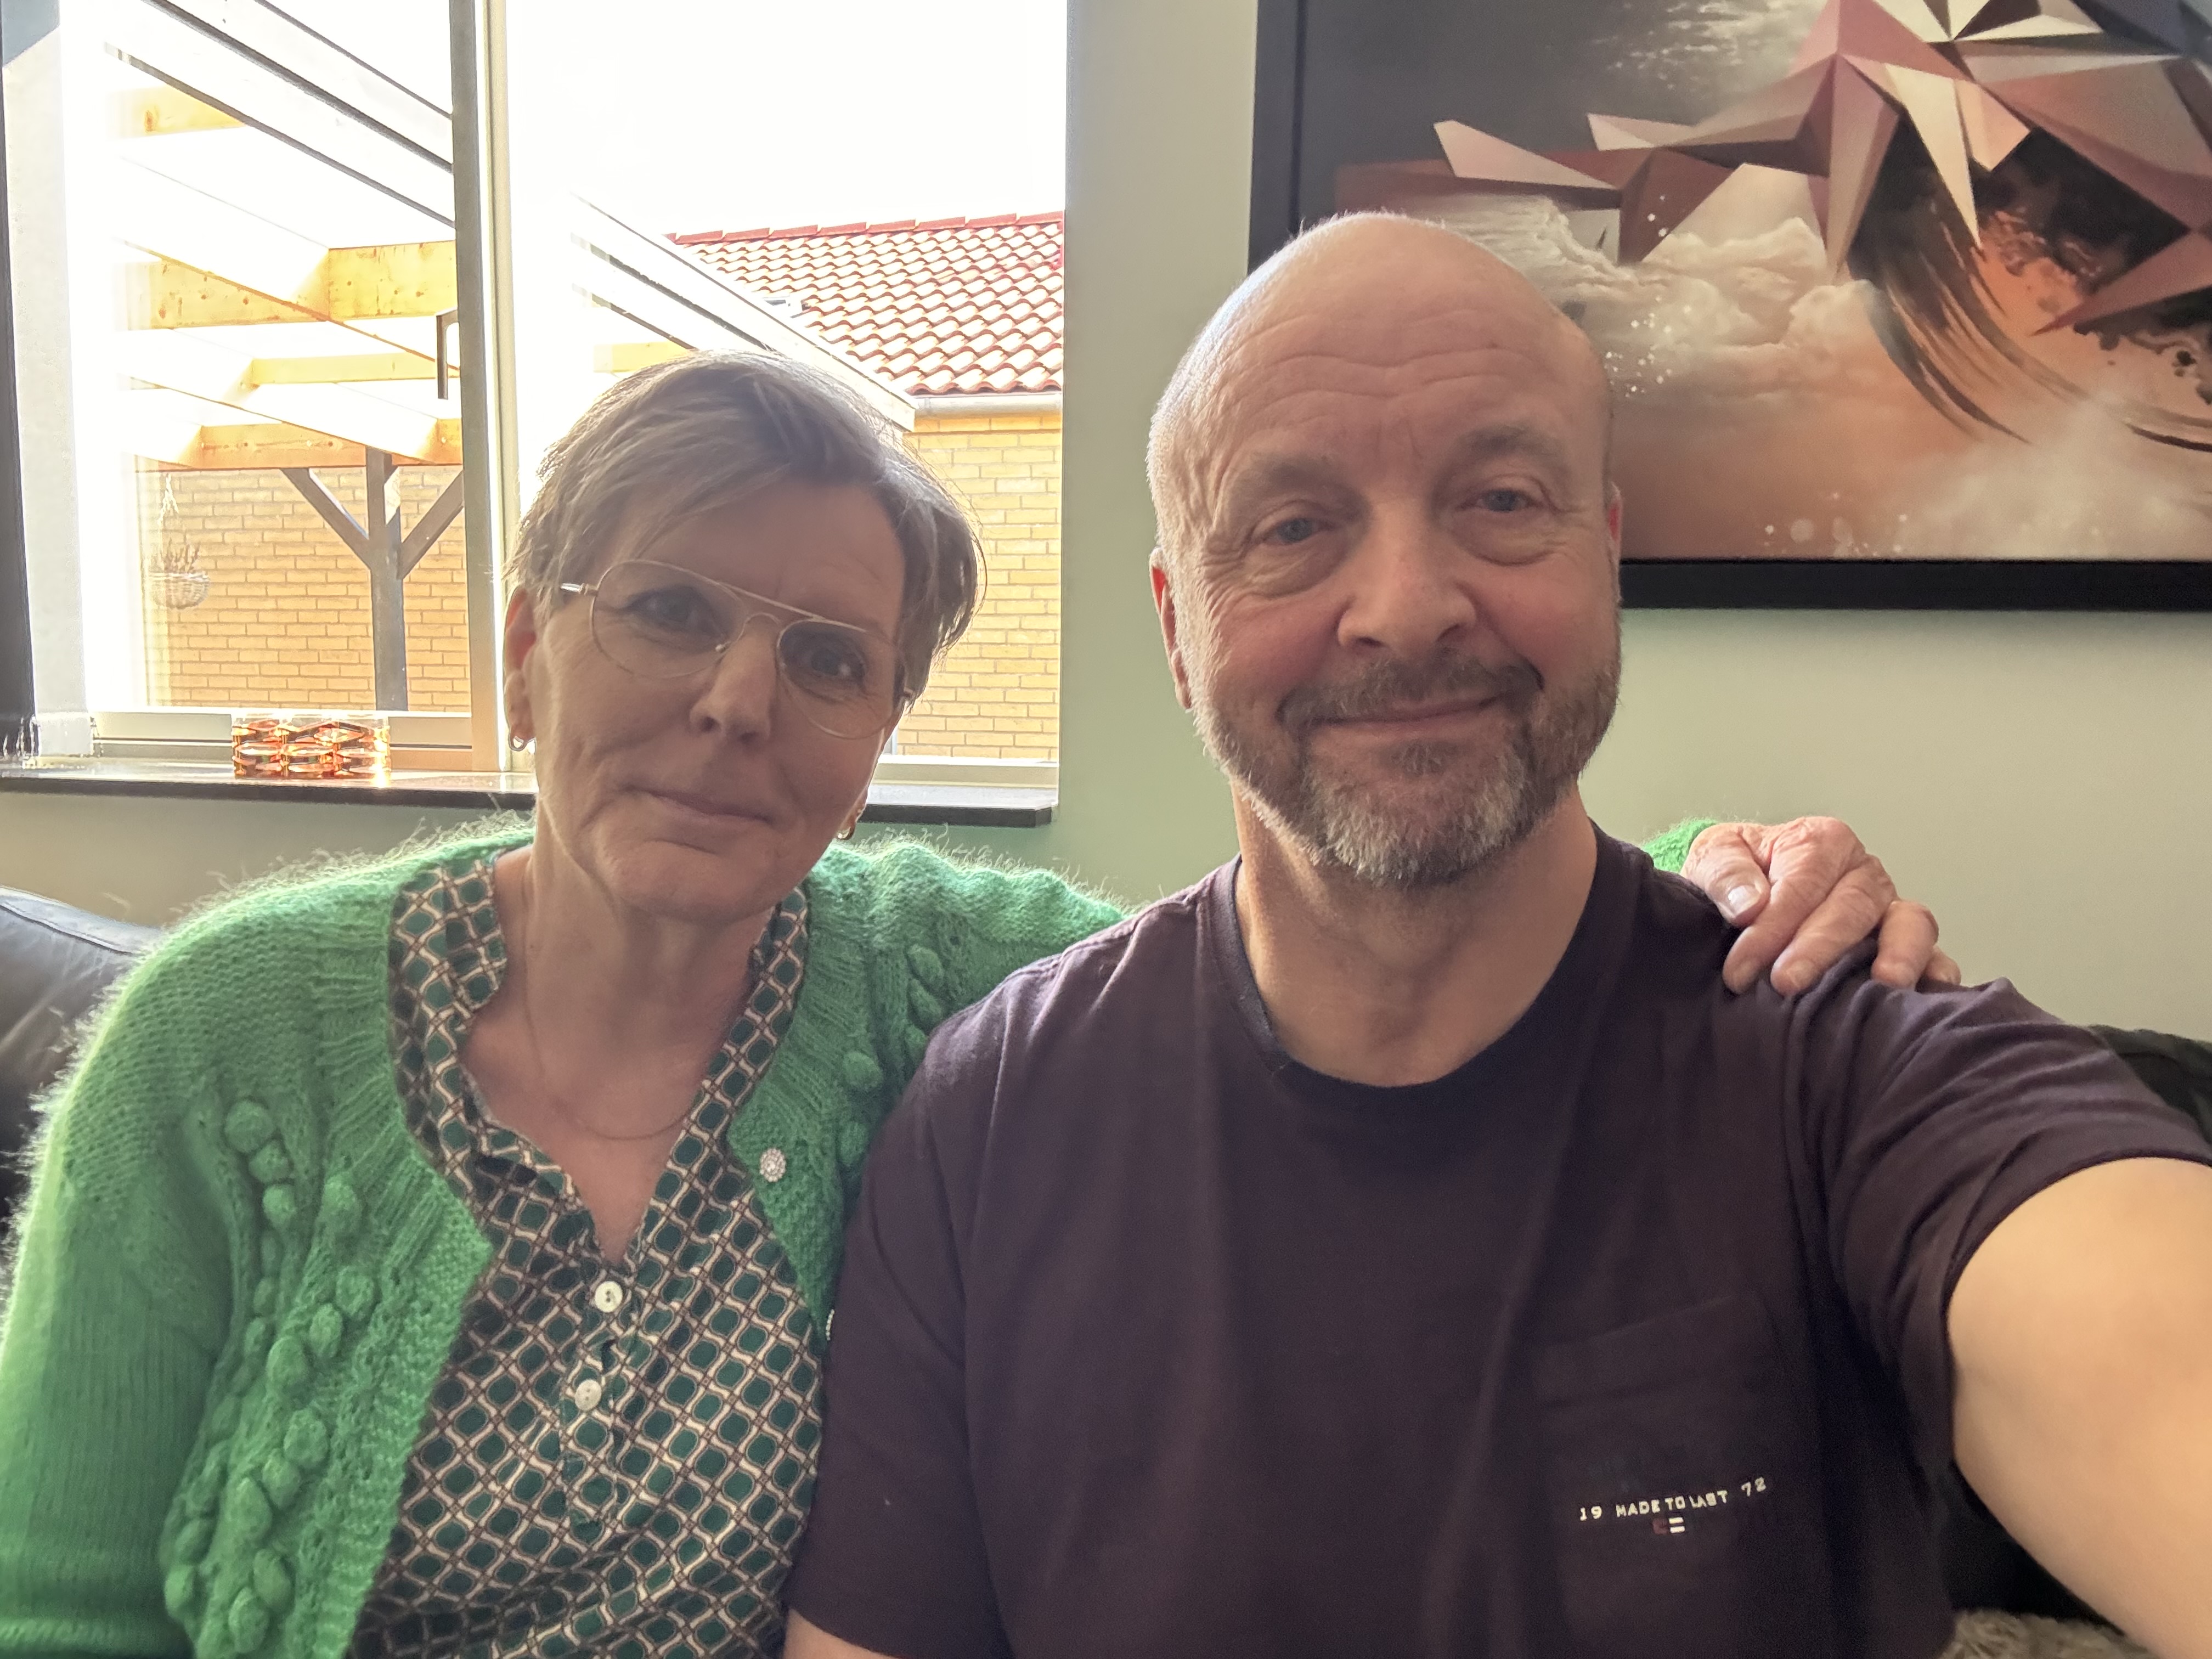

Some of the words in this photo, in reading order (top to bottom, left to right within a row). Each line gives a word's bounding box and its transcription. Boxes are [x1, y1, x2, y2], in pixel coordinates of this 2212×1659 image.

[1580, 1506, 1602, 1521] 19
[1616, 1499, 1661, 1517] MADE
[1665, 1496, 1686, 1511] TO
[1689, 1490, 1728, 1509] LAST
